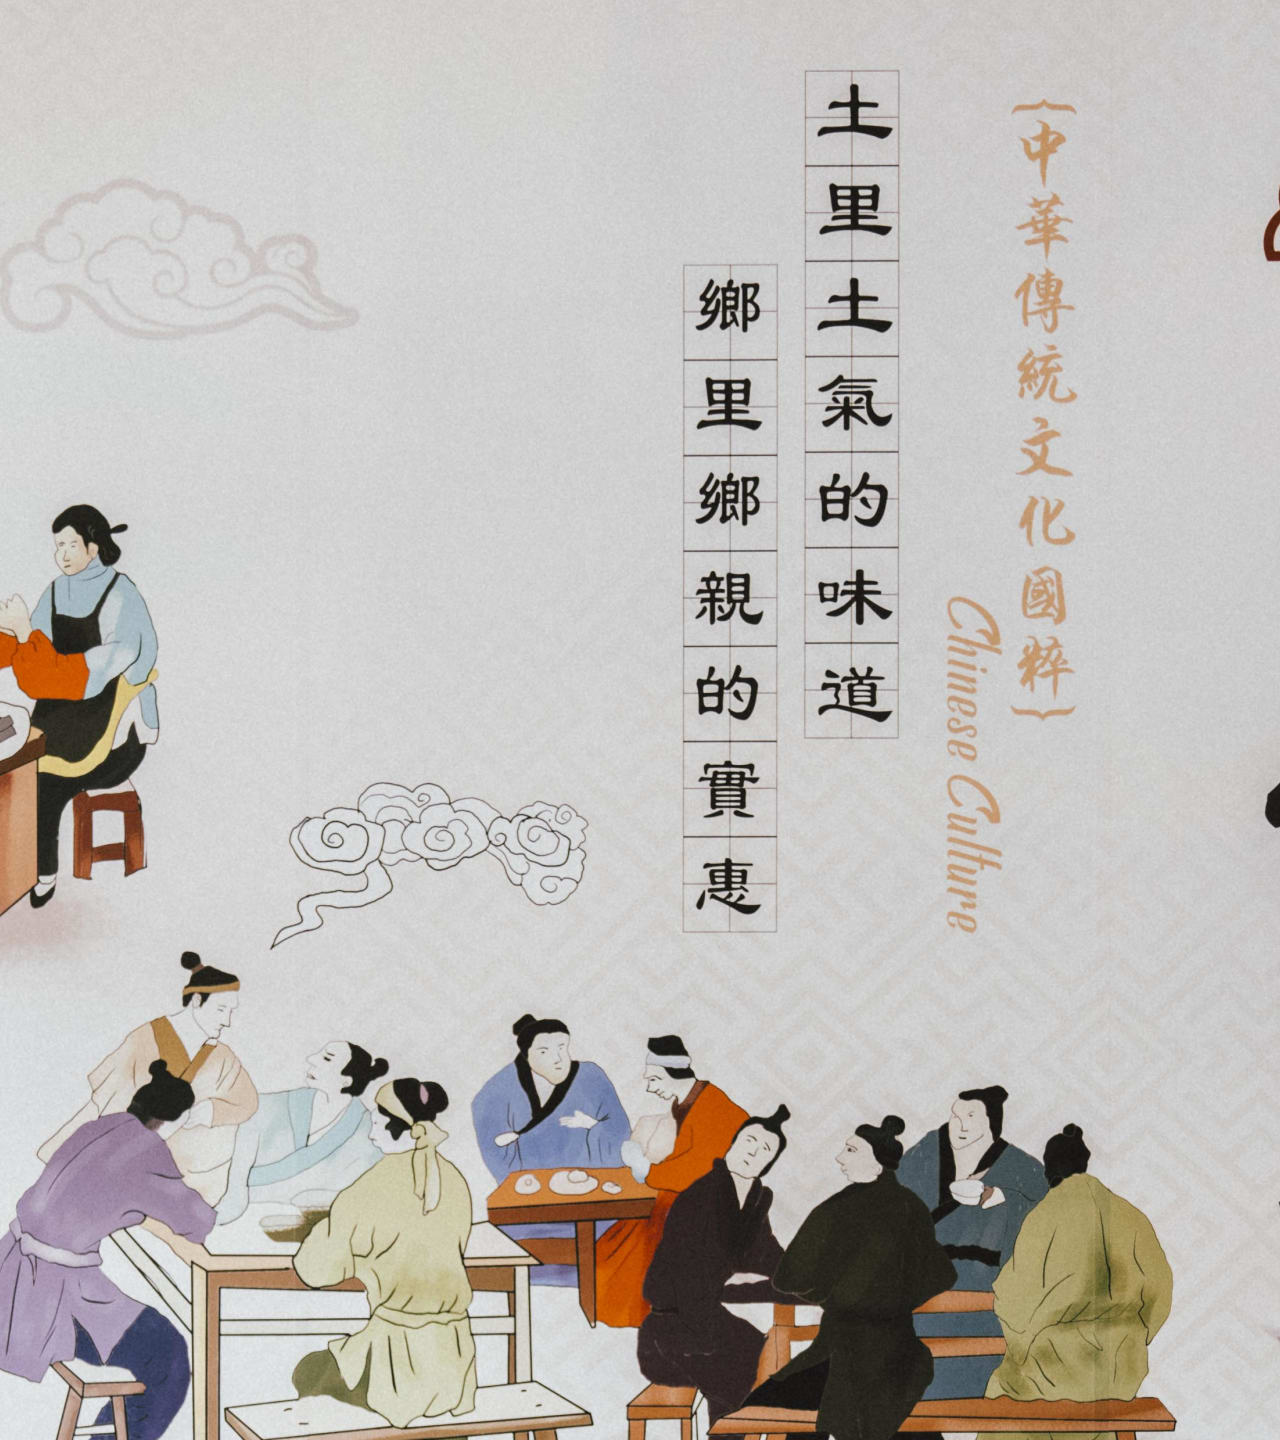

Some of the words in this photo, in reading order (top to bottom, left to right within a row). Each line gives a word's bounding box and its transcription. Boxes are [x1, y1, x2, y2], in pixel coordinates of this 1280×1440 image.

[695, 277, 764, 915] 鄉里鄉親的實惠
[817, 83, 893, 723] 土里土氣的味道
[947, 596, 1001, 762] Chinese
[947, 774, 1002, 933] Culture
